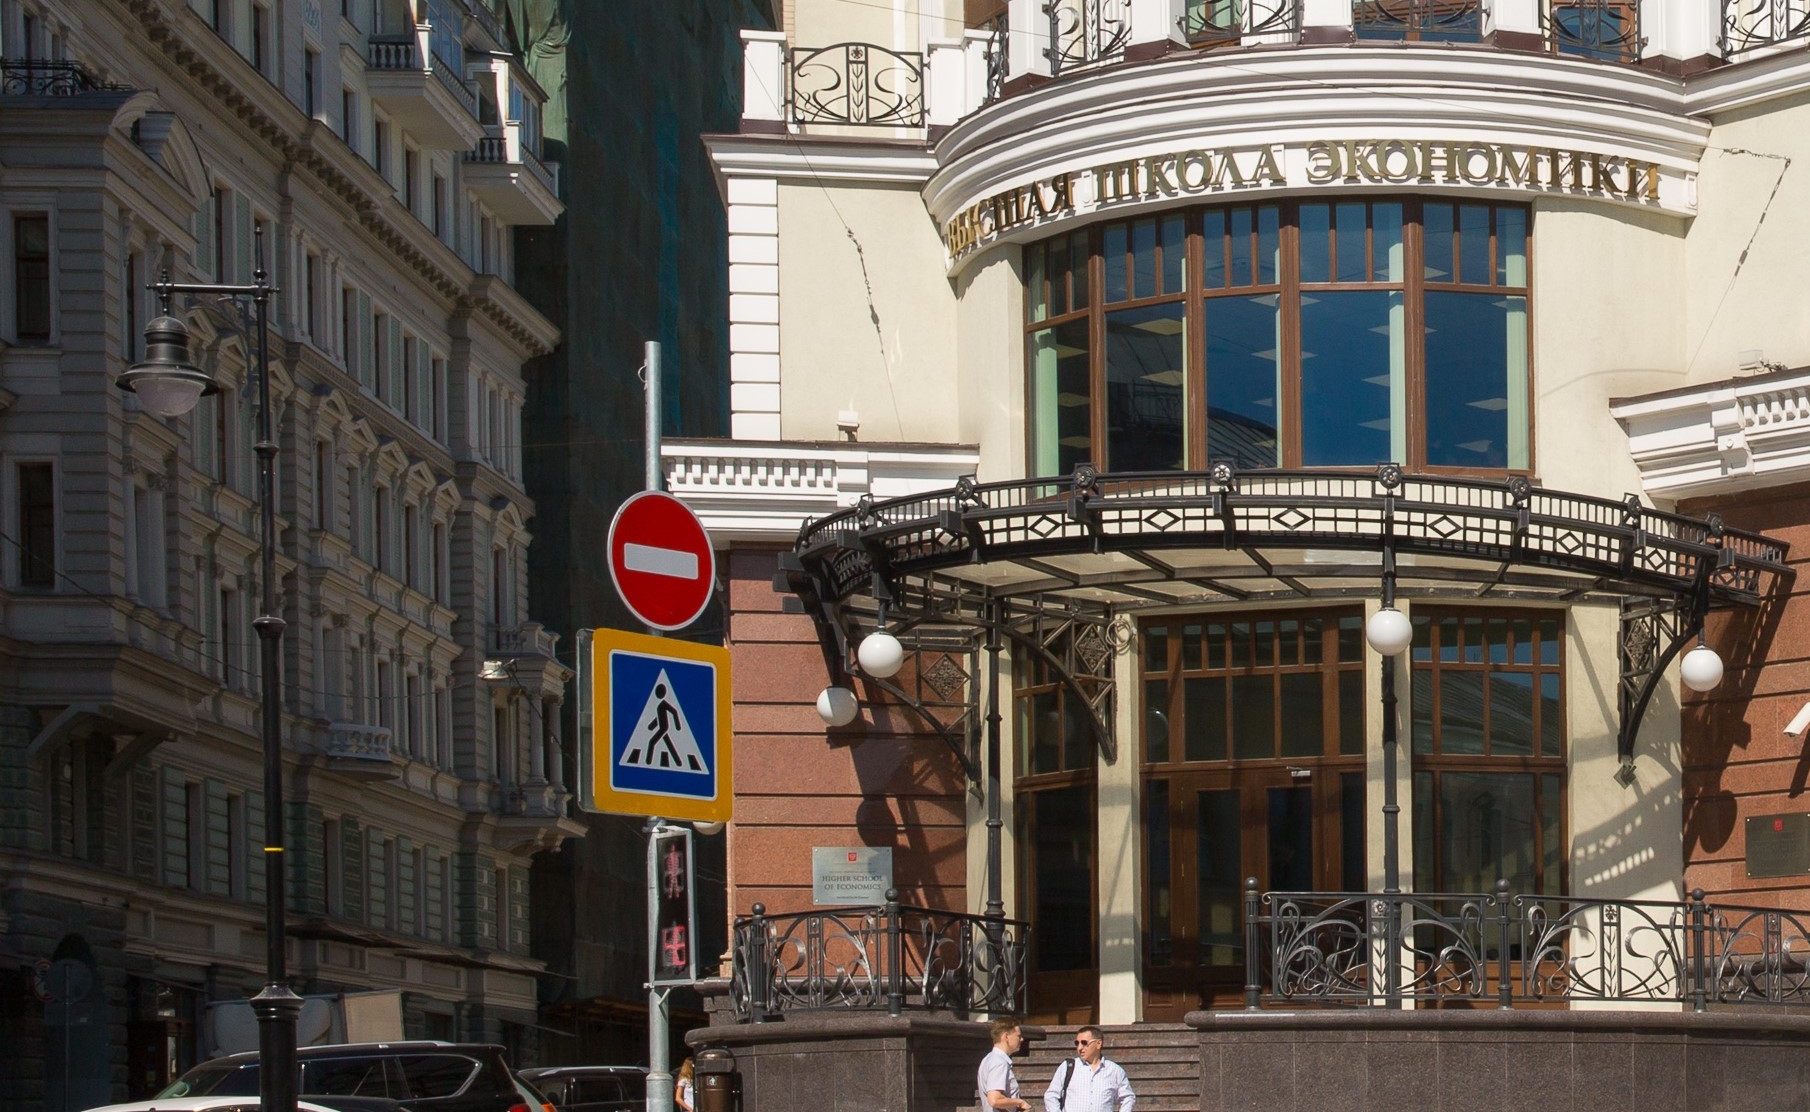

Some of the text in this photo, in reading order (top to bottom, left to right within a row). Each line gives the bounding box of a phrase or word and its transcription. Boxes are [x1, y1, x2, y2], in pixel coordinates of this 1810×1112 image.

[947, 138, 1661, 259] ВЫСШАЯ ШКОЛА ЭКОНОМИКИ
